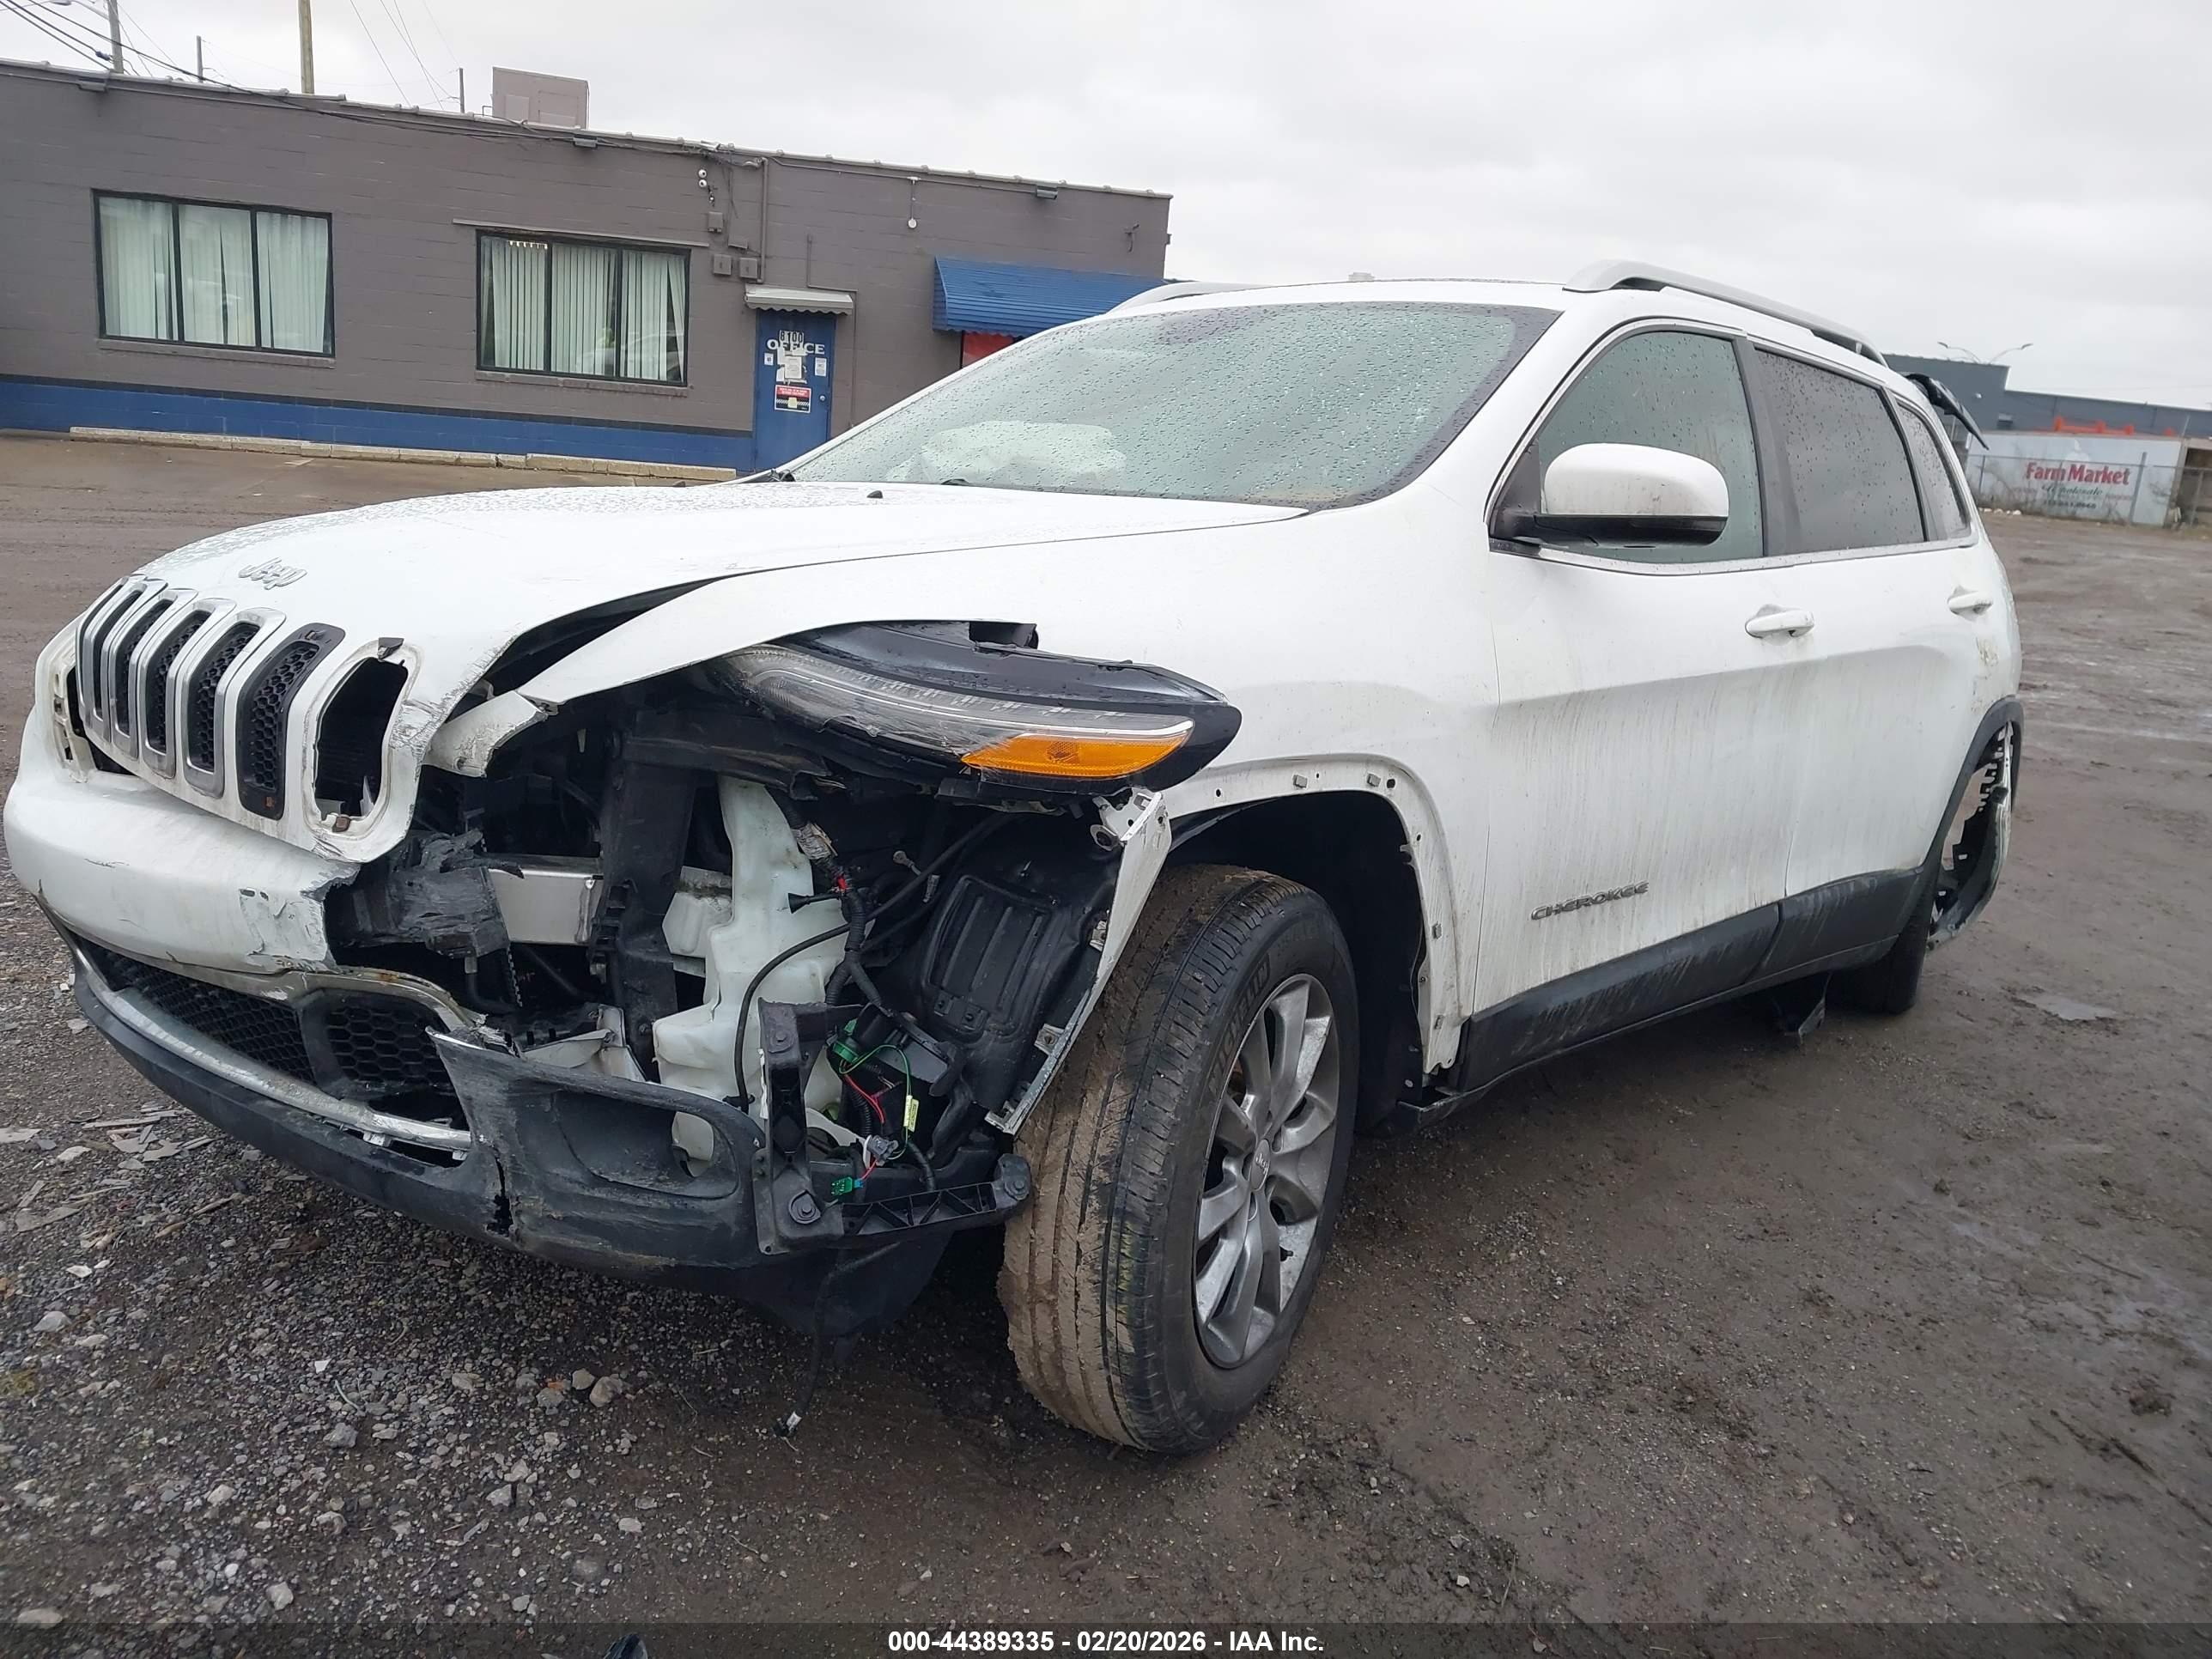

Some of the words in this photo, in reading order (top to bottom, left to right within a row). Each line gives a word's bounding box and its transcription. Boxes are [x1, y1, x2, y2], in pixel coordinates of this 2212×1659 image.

[767, 339, 825, 355] OFFICE
[780, 331, 804, 343] 8100
[2026, 462, 2066, 482] Farm
[2068, 464, 2130, 485] Market
[238, 556, 307, 590] Jeep
[1530, 880, 1650, 920] CHEROKEE
